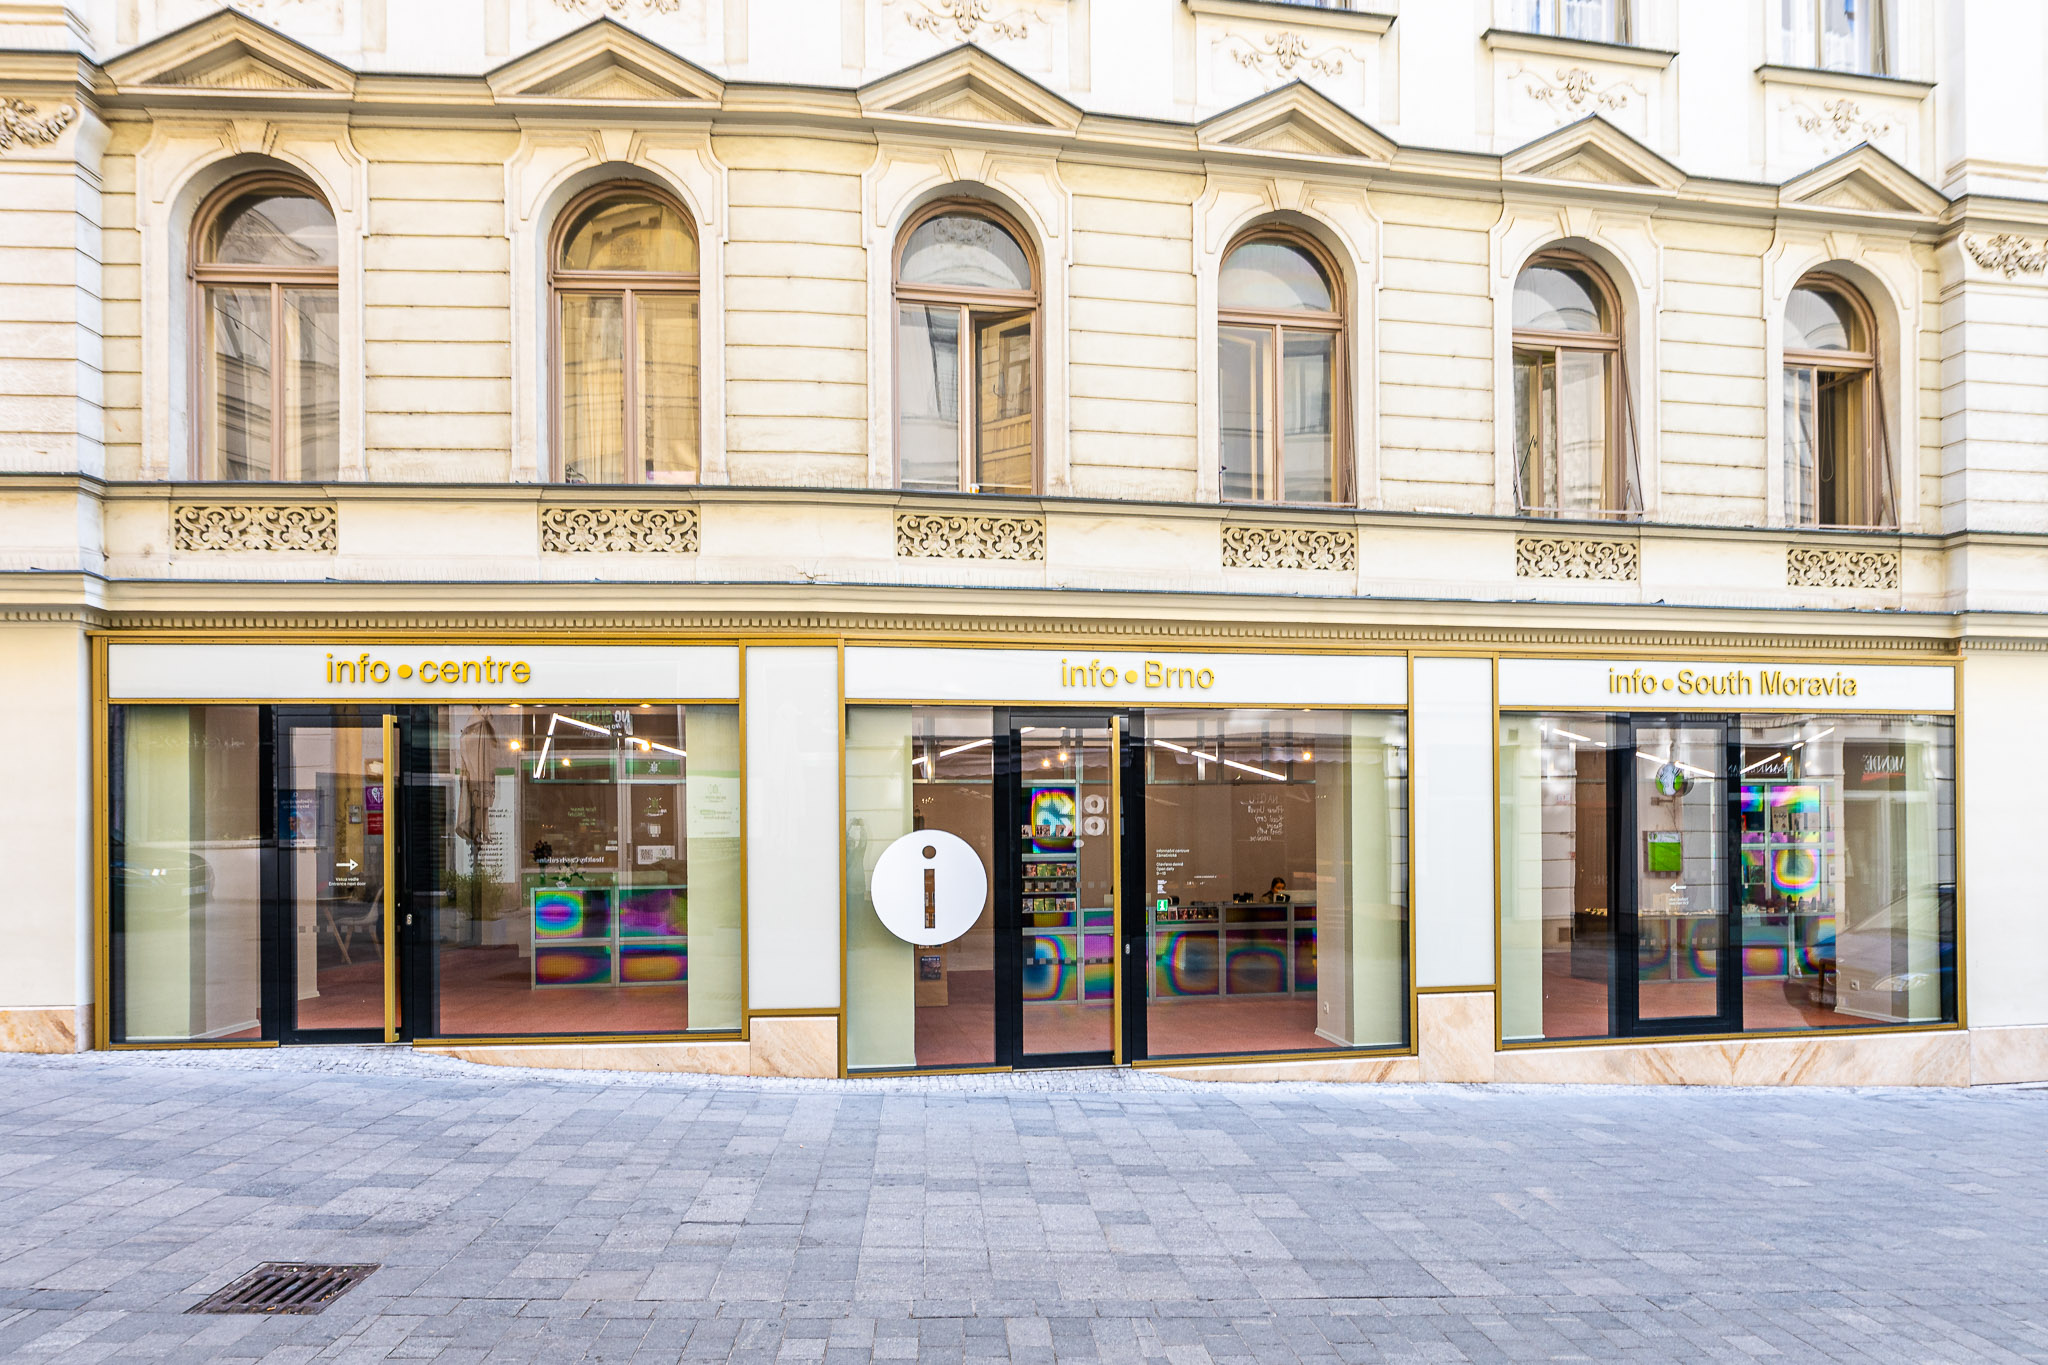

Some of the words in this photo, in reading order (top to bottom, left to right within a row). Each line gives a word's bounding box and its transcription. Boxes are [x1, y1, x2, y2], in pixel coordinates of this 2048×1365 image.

[326, 652, 391, 684] info
[418, 655, 532, 684] centre
[1061, 657, 1119, 688] info
[1144, 659, 1215, 689] Brno
[1609, 667, 1658, 695] info
[1678, 668, 1753, 696] South
[1760, 670, 1858, 697] Moravia
